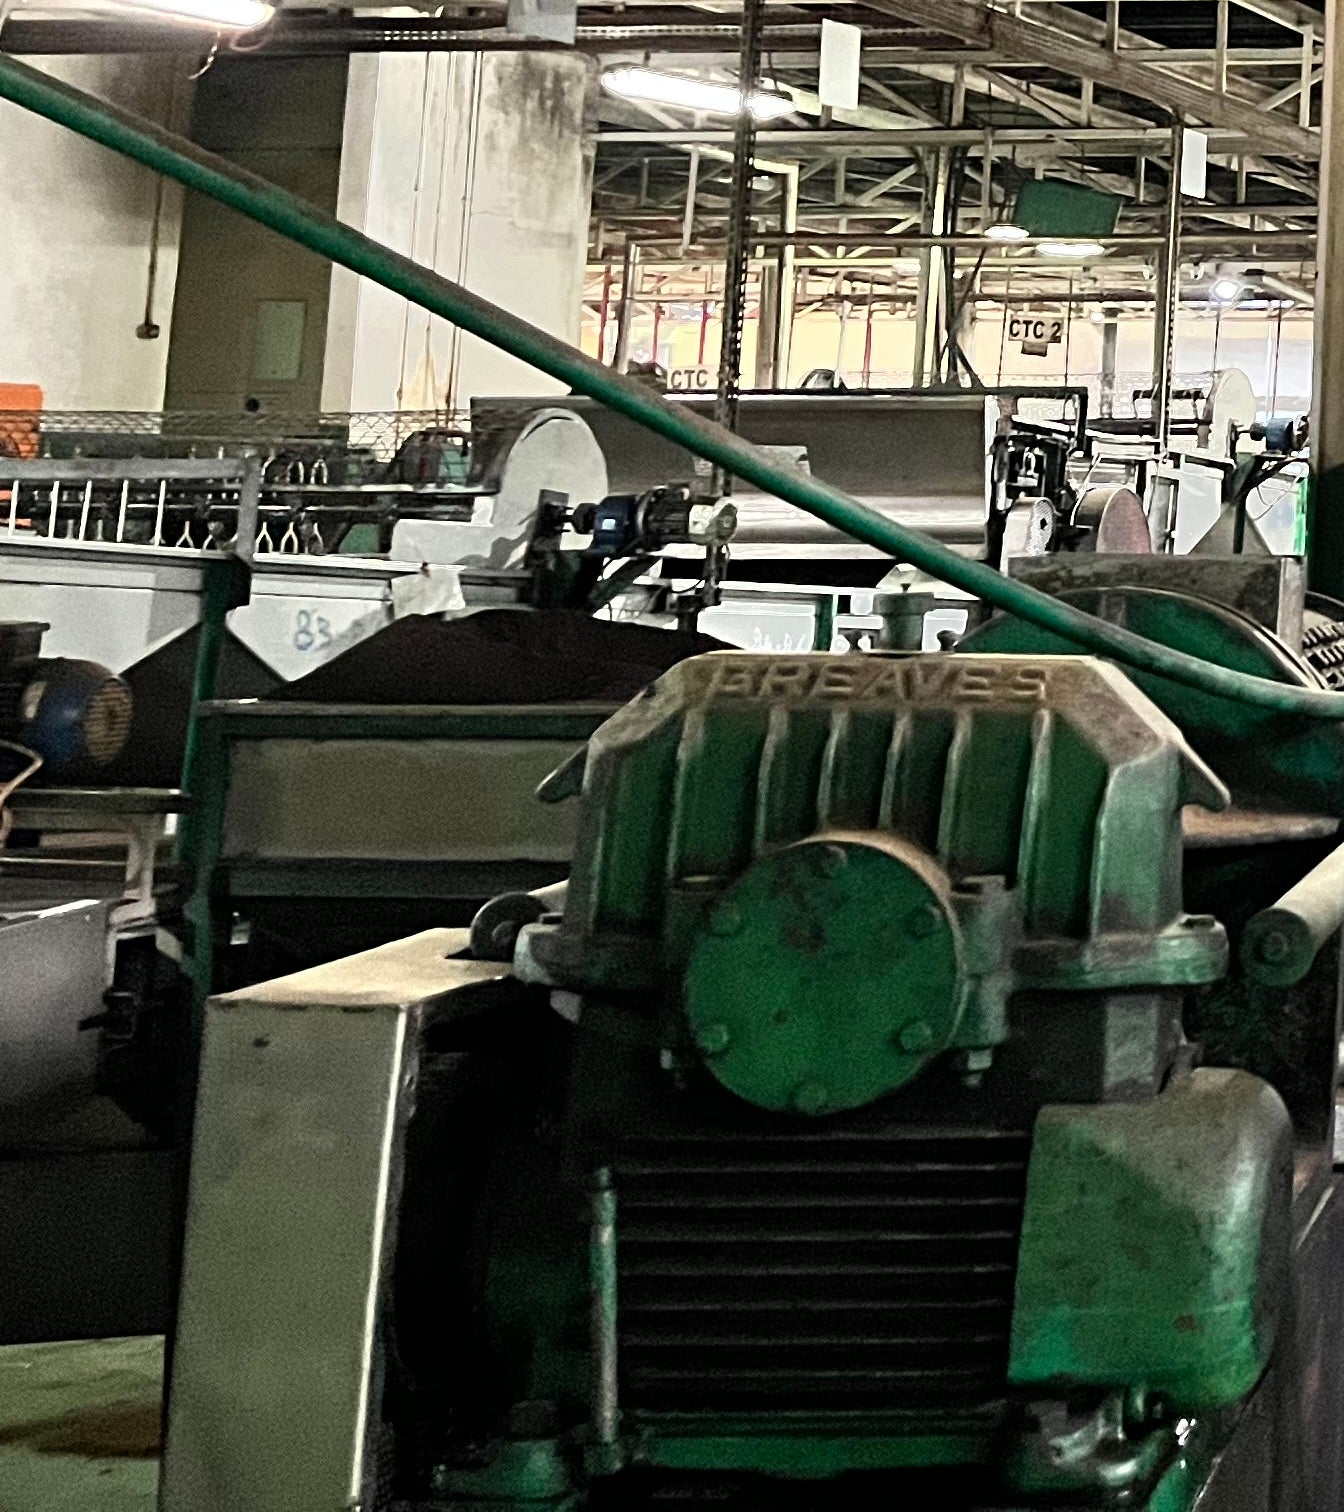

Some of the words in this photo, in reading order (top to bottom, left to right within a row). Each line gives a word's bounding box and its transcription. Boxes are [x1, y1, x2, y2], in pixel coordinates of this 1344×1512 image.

[1009, 319, 1045, 339] CTC
[1050, 321, 1061, 341] 2
[671, 369, 708, 388] CTC
